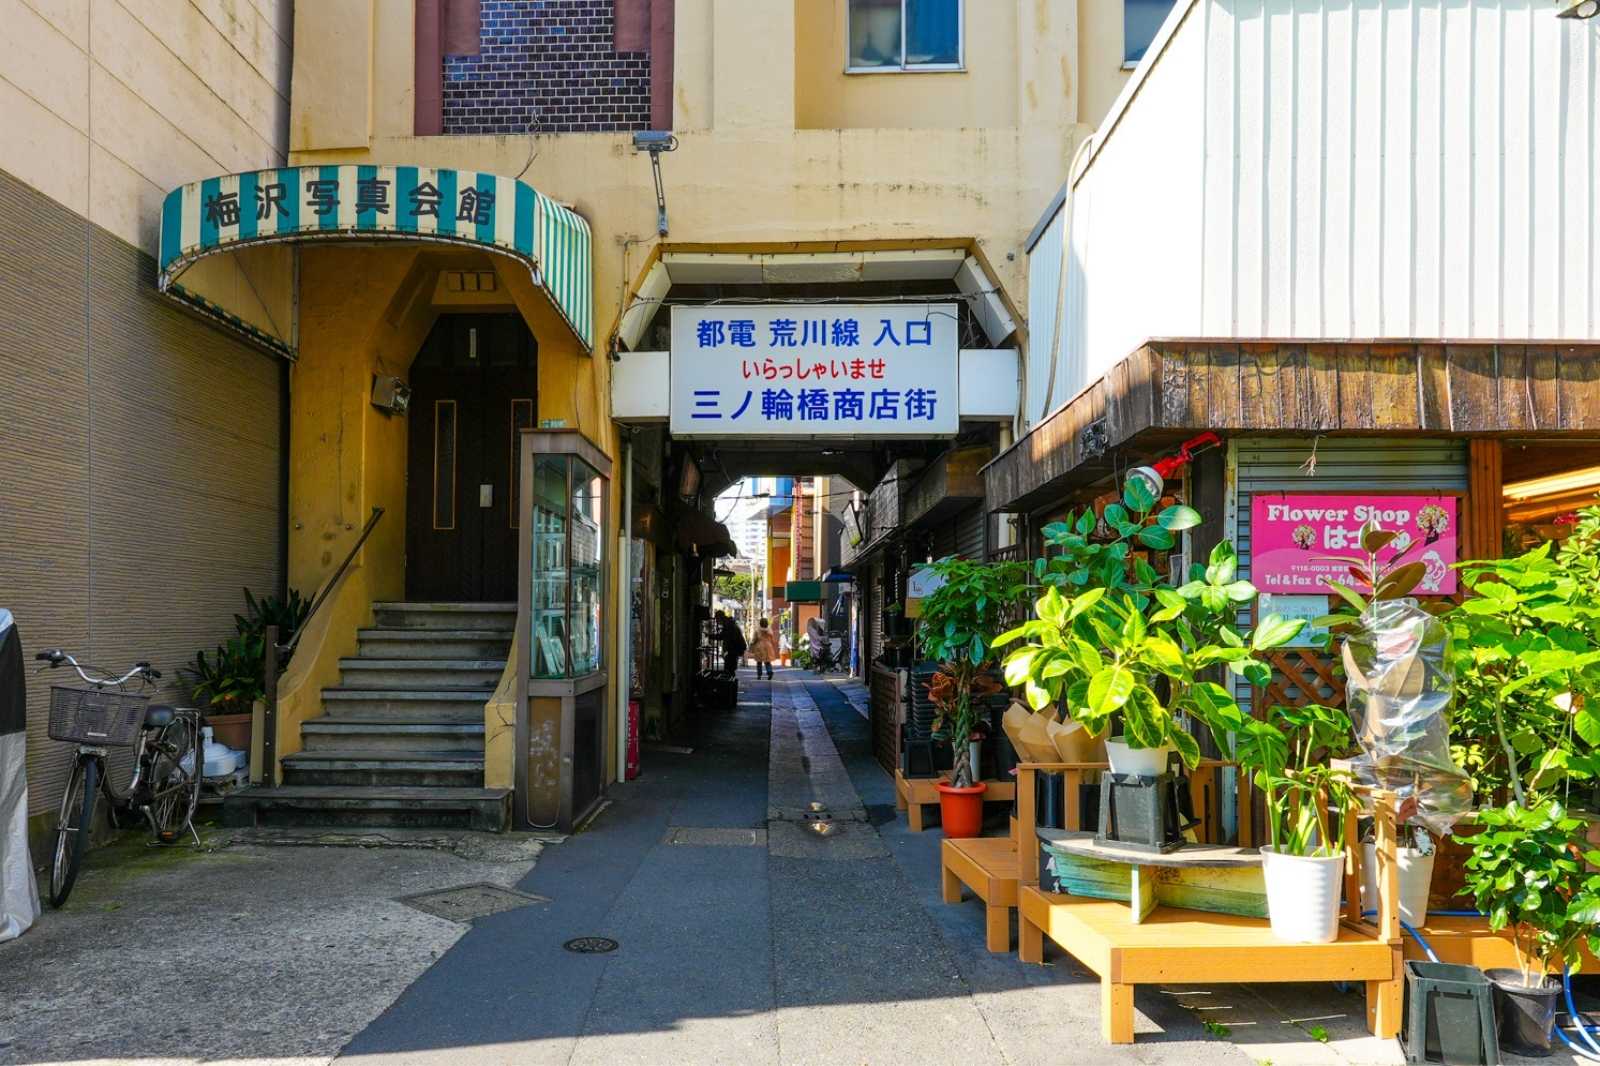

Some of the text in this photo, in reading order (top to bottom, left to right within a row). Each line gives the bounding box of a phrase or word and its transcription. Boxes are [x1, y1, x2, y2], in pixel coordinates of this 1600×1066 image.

[205, 177, 496, 229] 梅沢写真会館
[696, 318, 932, 347] 都電 荒川線 入口
[742, 358, 887, 380] いらっしゃいませ
[691, 389, 938, 422] 三ノ輪橋商店街
[1267, 504, 1411, 525] Flower Shop
